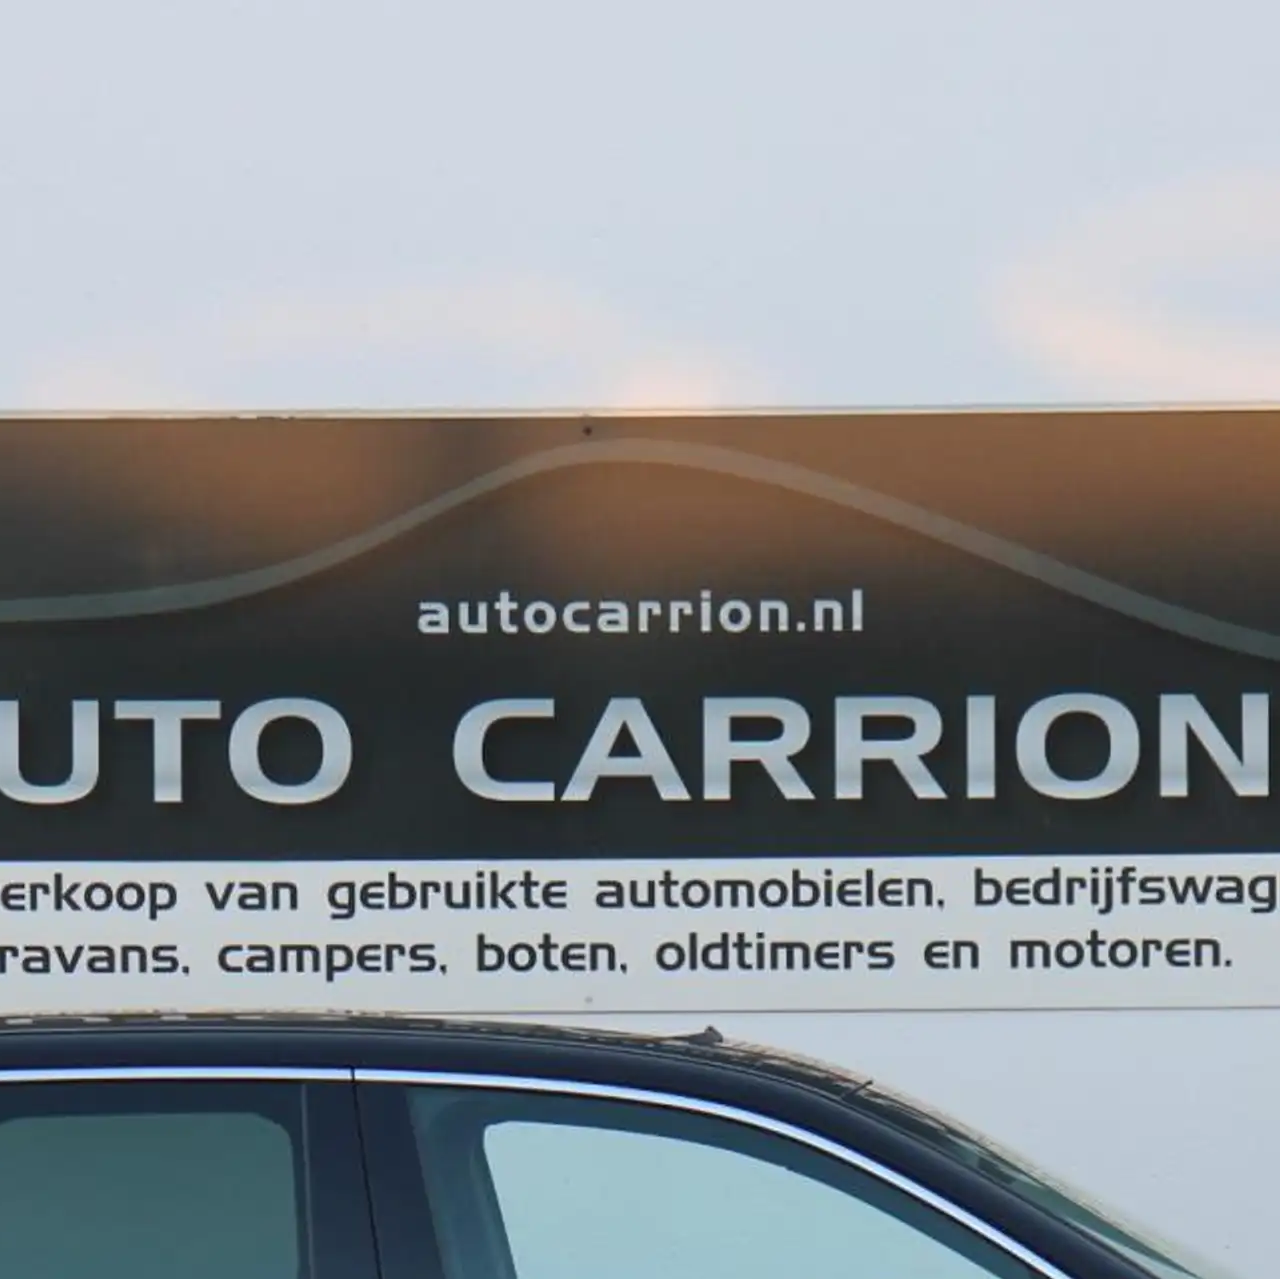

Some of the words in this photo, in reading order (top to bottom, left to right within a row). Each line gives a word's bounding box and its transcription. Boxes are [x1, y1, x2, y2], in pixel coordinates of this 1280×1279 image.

[418, 589, 863, 634] autocarrion.nl
[453, 693, 1270, 802] CARRION
[205, 881, 298, 911] van
[327, 870, 567, 920] gebruikte
[595, 868, 945, 909] automobielen,
[655, 931, 895, 972] oldtimers
[923, 940, 980, 970] en
[1010, 929, 1232, 969] motoren.
